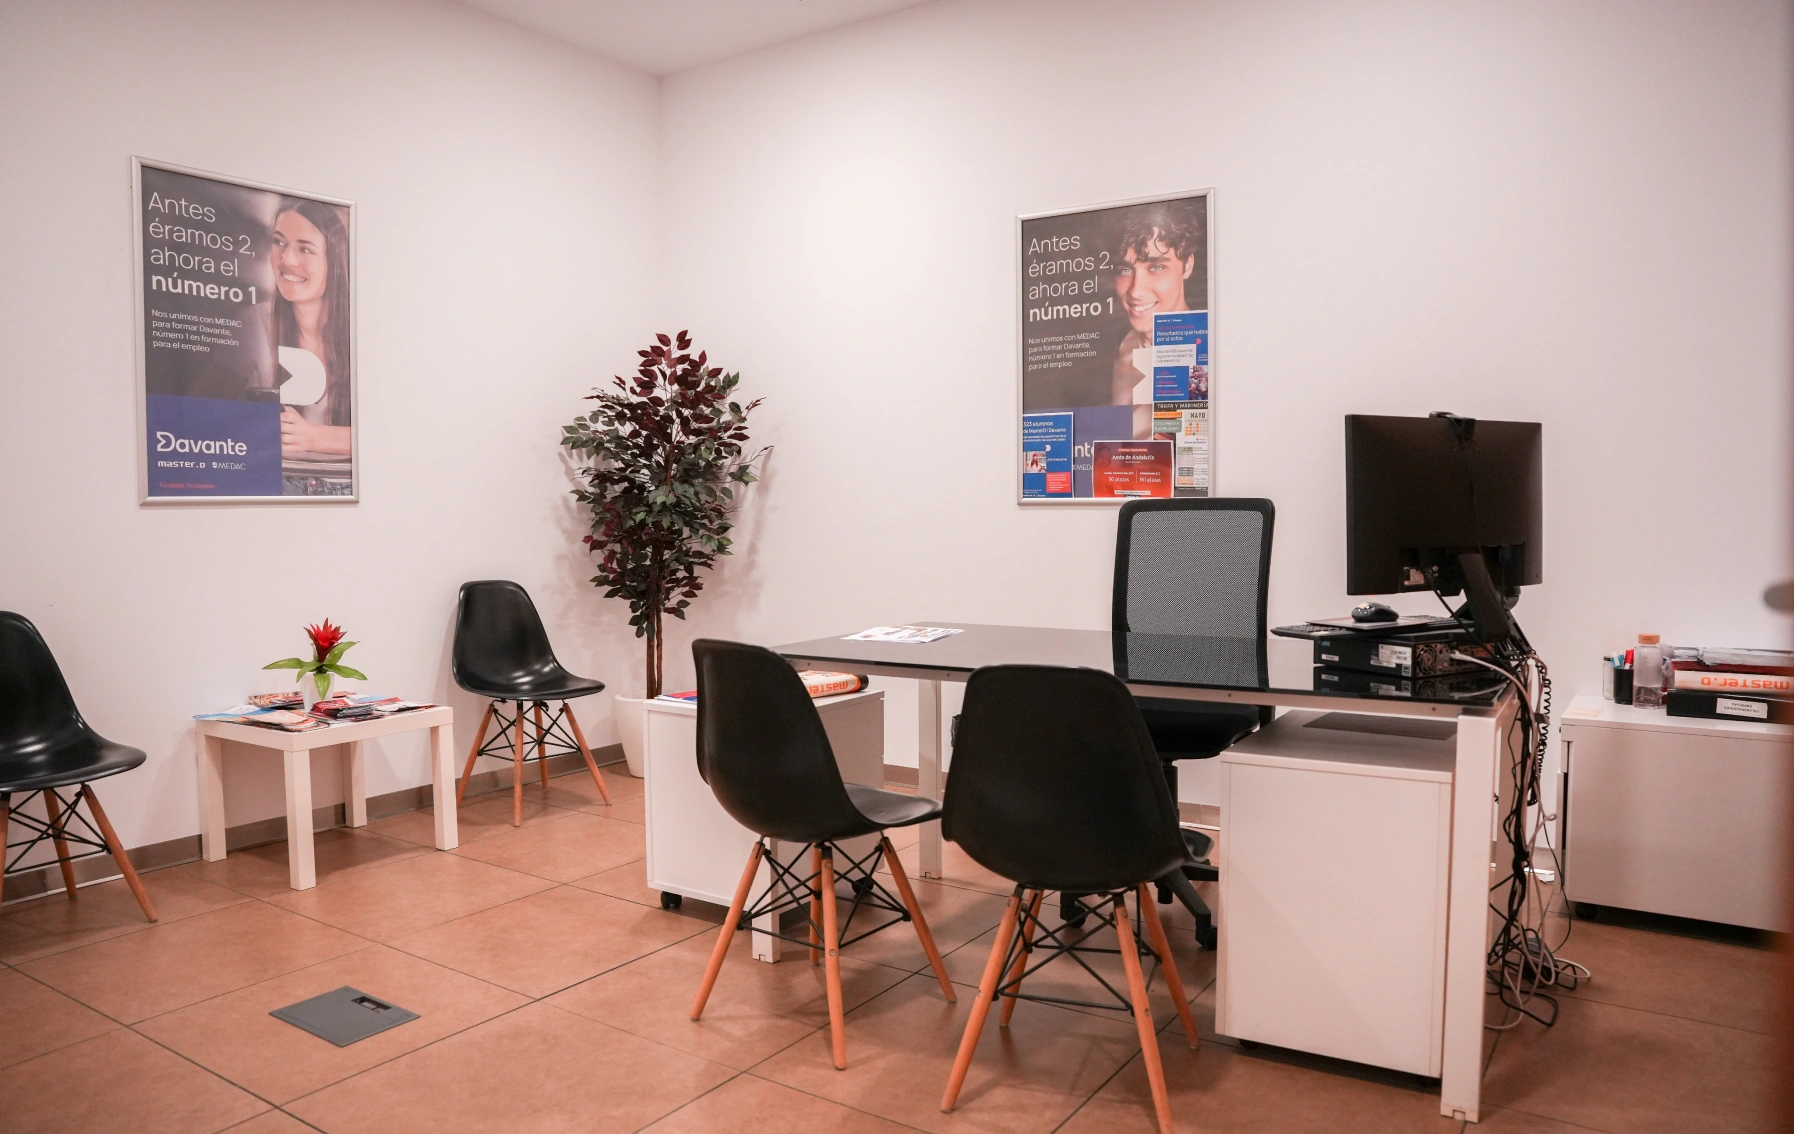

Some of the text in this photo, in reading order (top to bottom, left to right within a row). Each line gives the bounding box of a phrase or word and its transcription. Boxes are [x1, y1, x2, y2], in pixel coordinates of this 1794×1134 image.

[148, 191, 216, 222] Antes
[149, 217, 255, 257] éramos 2,
[1028, 235, 1080, 255] Antes
[150, 246, 238, 277] ahora el
[1028, 251, 1114, 277] éramos 2,
[151, 271, 257, 305] número 1
[1028, 275, 1098, 300] ahora el
[151, 308, 242, 328] Nos unimos con MEDAC
[1029, 297, 1114, 322] número 1
[152, 320, 232, 337] para formar Davante,
[152, 329, 184, 340] número
[190, 334, 200, 342] en
[201, 335, 239, 347] formación
[1041, 335, 1063, 344] unimos
[1077, 332, 1100, 340] MEDAC
[153, 340, 210, 353] para el empleo
[1028, 346, 1042, 354] para
[1043, 343, 1063, 352] formar
[1028, 353, 1052, 362] número
[1066, 349, 1097, 359] formación
[1028, 363, 1042, 372] para
[1050, 360, 1073, 369] empleo
[156, 431, 248, 456] Davante
[218, 462, 247, 471] MEDAC
